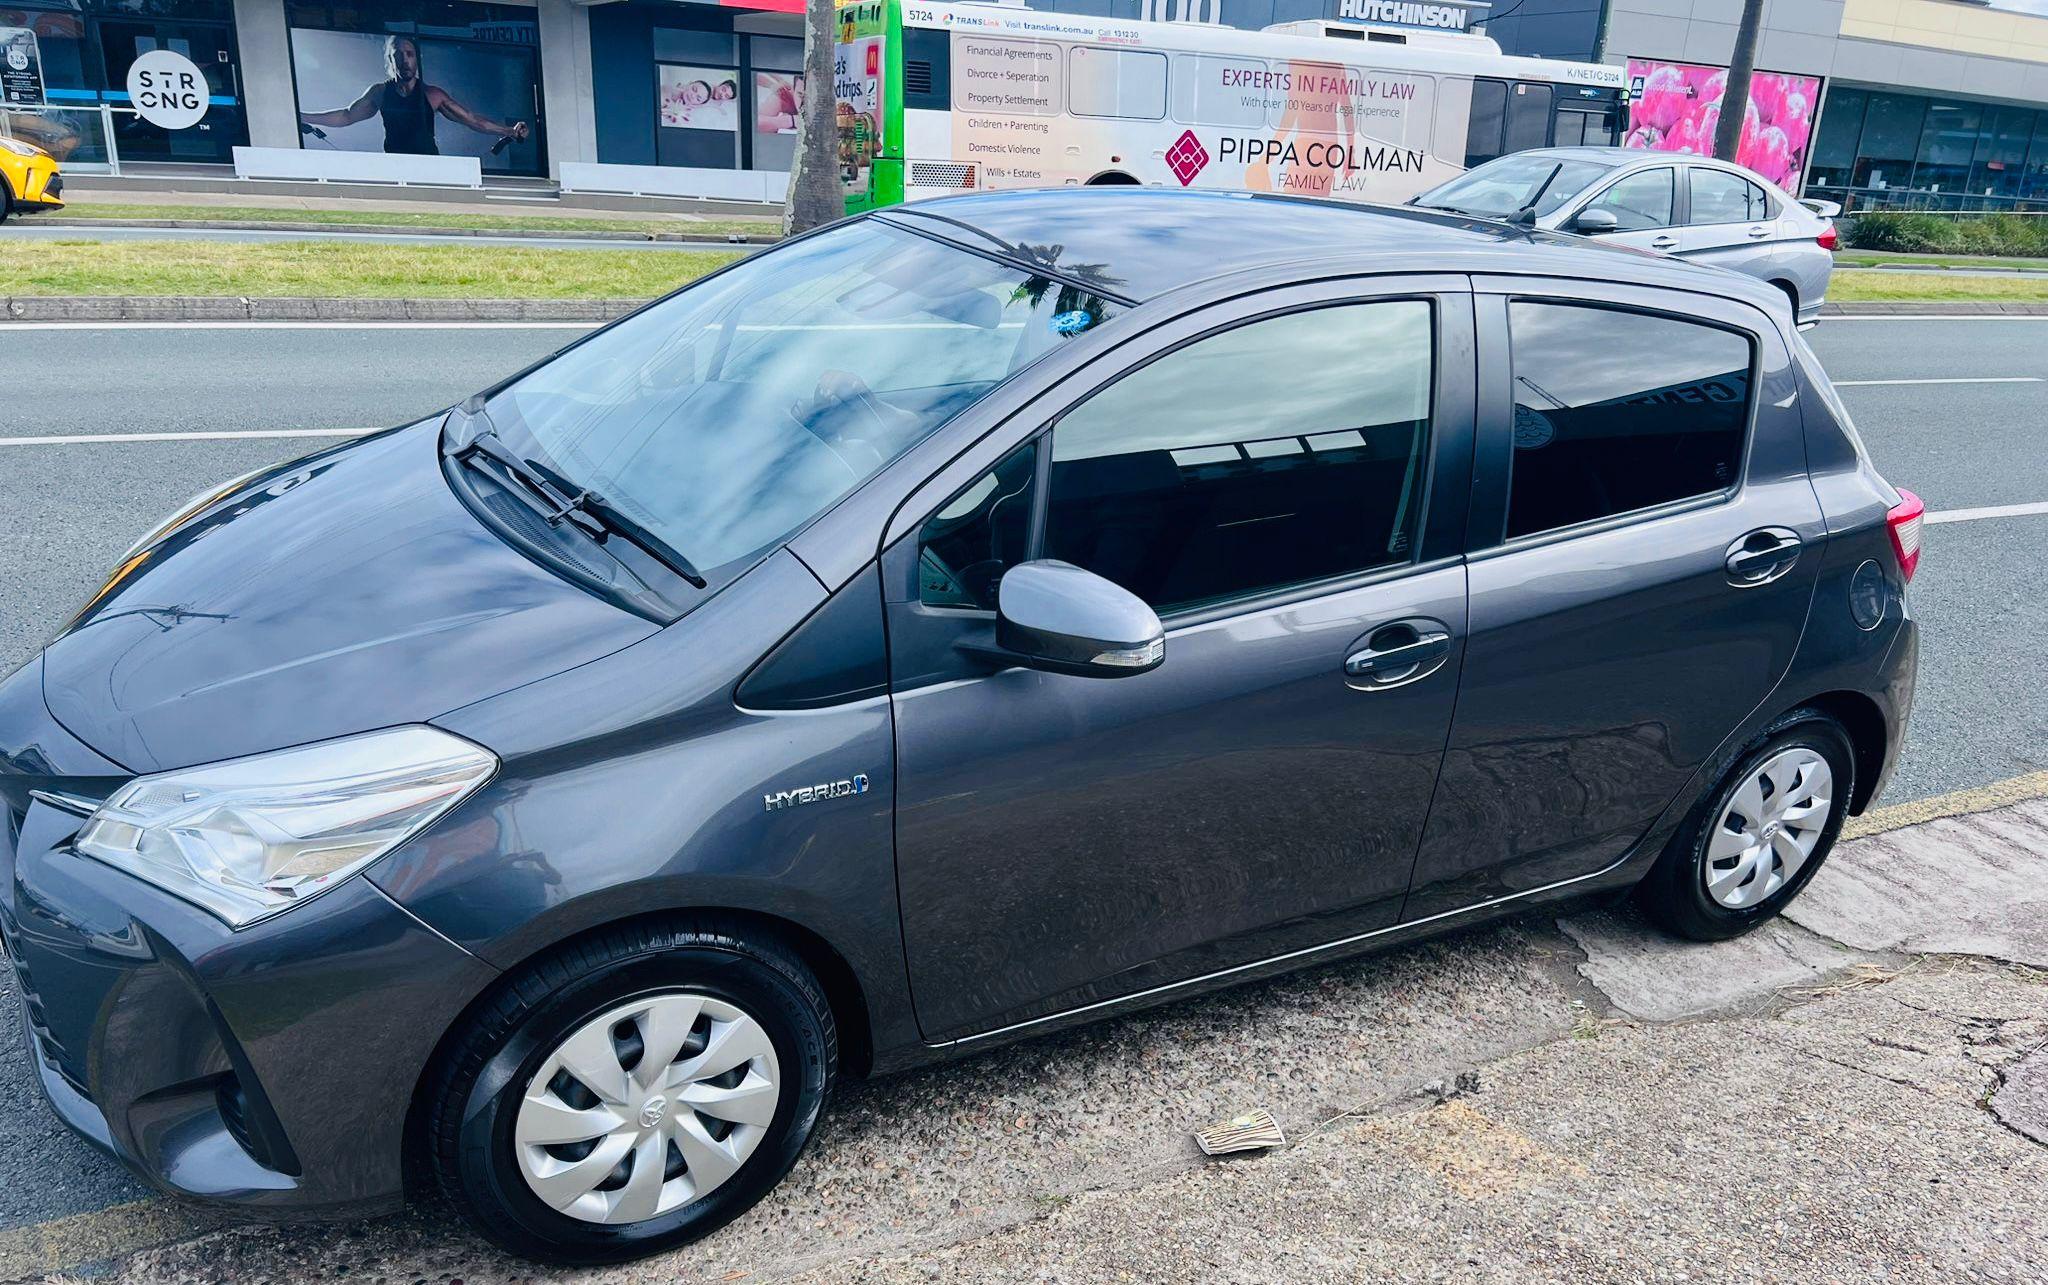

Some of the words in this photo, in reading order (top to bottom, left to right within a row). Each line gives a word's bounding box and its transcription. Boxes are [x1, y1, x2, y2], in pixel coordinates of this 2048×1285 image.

[909, 10, 933, 21] 5724
[1339, 0, 1467, 29] HUTCHINSON
[1005, 20, 1021, 29] Visit
[1024, 22, 1093, 35] translink.com.au
[967, 45, 1003, 57] Financial
[1004, 47, 1053, 62] Agreements
[967, 68, 998, 79] Divorce
[1006, 71, 1049, 84] Seperation
[1567, 68, 1603, 80] K/NET/C
[1604, 73, 1619, 82] 5724
[1222, 69, 1292, 91] EXPERTS
[1298, 75, 1317, 92] IN
[1320, 76, 1376, 98] FAMILY
[1382, 82, 1416, 101] LAW
[968, 93, 1003, 105] Property
[1004, 94, 1048, 106] Settlement
[1240, 95, 1260, 108] With
[1262, 100, 1282, 109] over
[1284, 100, 1299, 111] 100
[1301, 101, 1323, 112] Years
[1324, 102, 1333, 113] of
[1335, 103, 1355, 117] Legal
[1358, 104, 1400, 118] Experience
[968, 118, 1002, 130] Children
[1010, 120, 1049, 133] Parenting
[968, 142, 1006, 154] Domestic
[1007, 145, 1041, 155] Violence
[1219, 138, 1299, 166] PIPPA
[1306, 143, 1424, 173] COLMAN
[986, 168, 1005, 178] Wills
[1013, 169, 1041, 178] Estates
[1278, 173, 1329, 191] FAMILY
[1332, 175, 1366, 192] LAW
[764, 780, 852, 811] HYBRID
